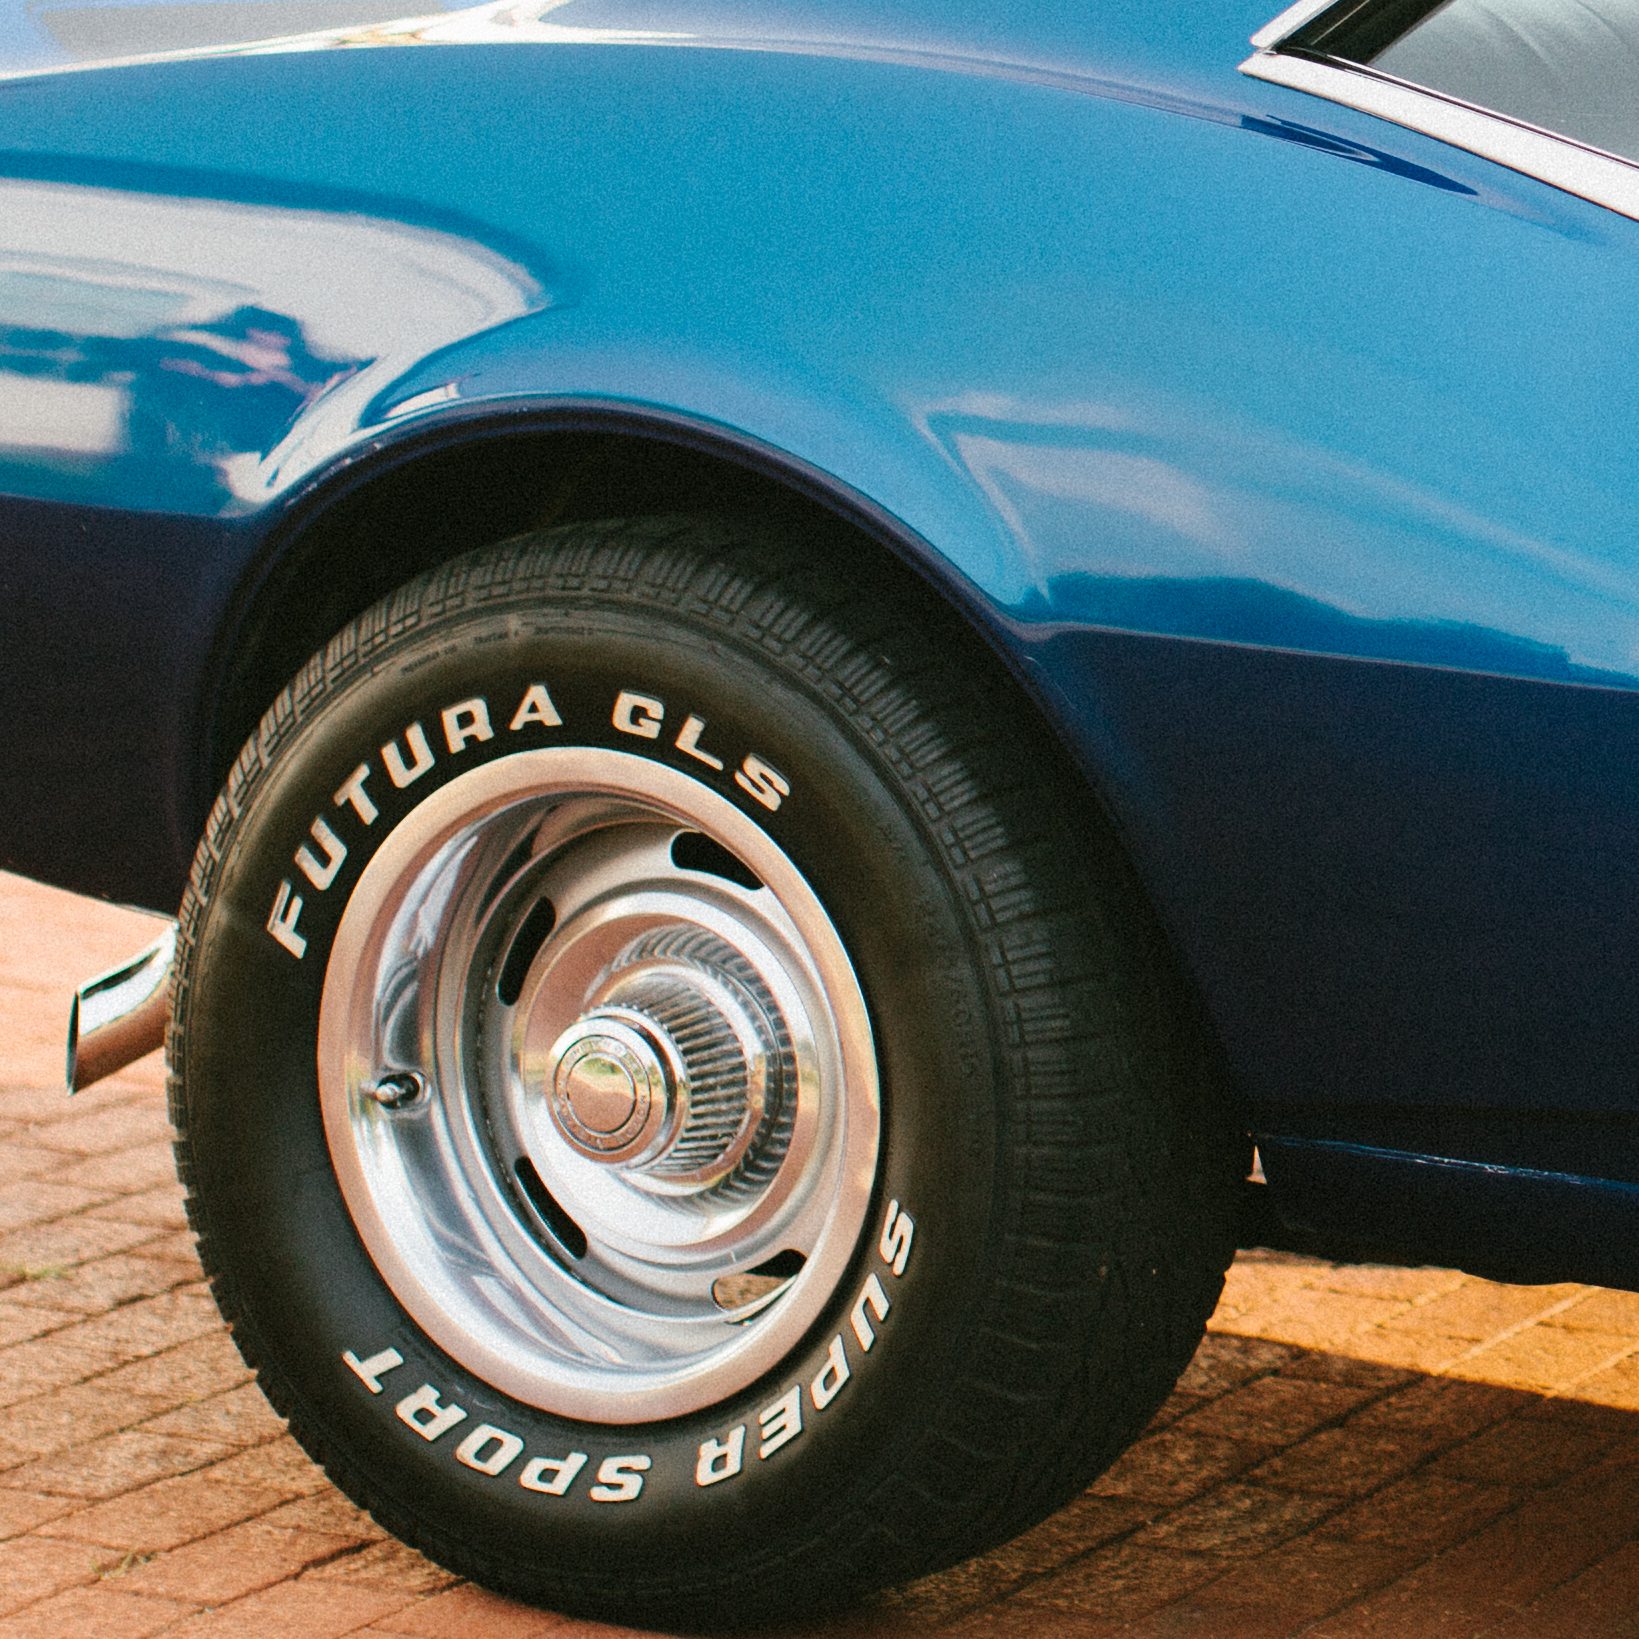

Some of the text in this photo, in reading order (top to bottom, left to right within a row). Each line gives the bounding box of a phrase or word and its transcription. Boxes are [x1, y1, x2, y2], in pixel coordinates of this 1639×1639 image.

[267, 685, 791, 959] FUTURA GLS
[342, 1197, 915, 1502] SUPER SPORT
